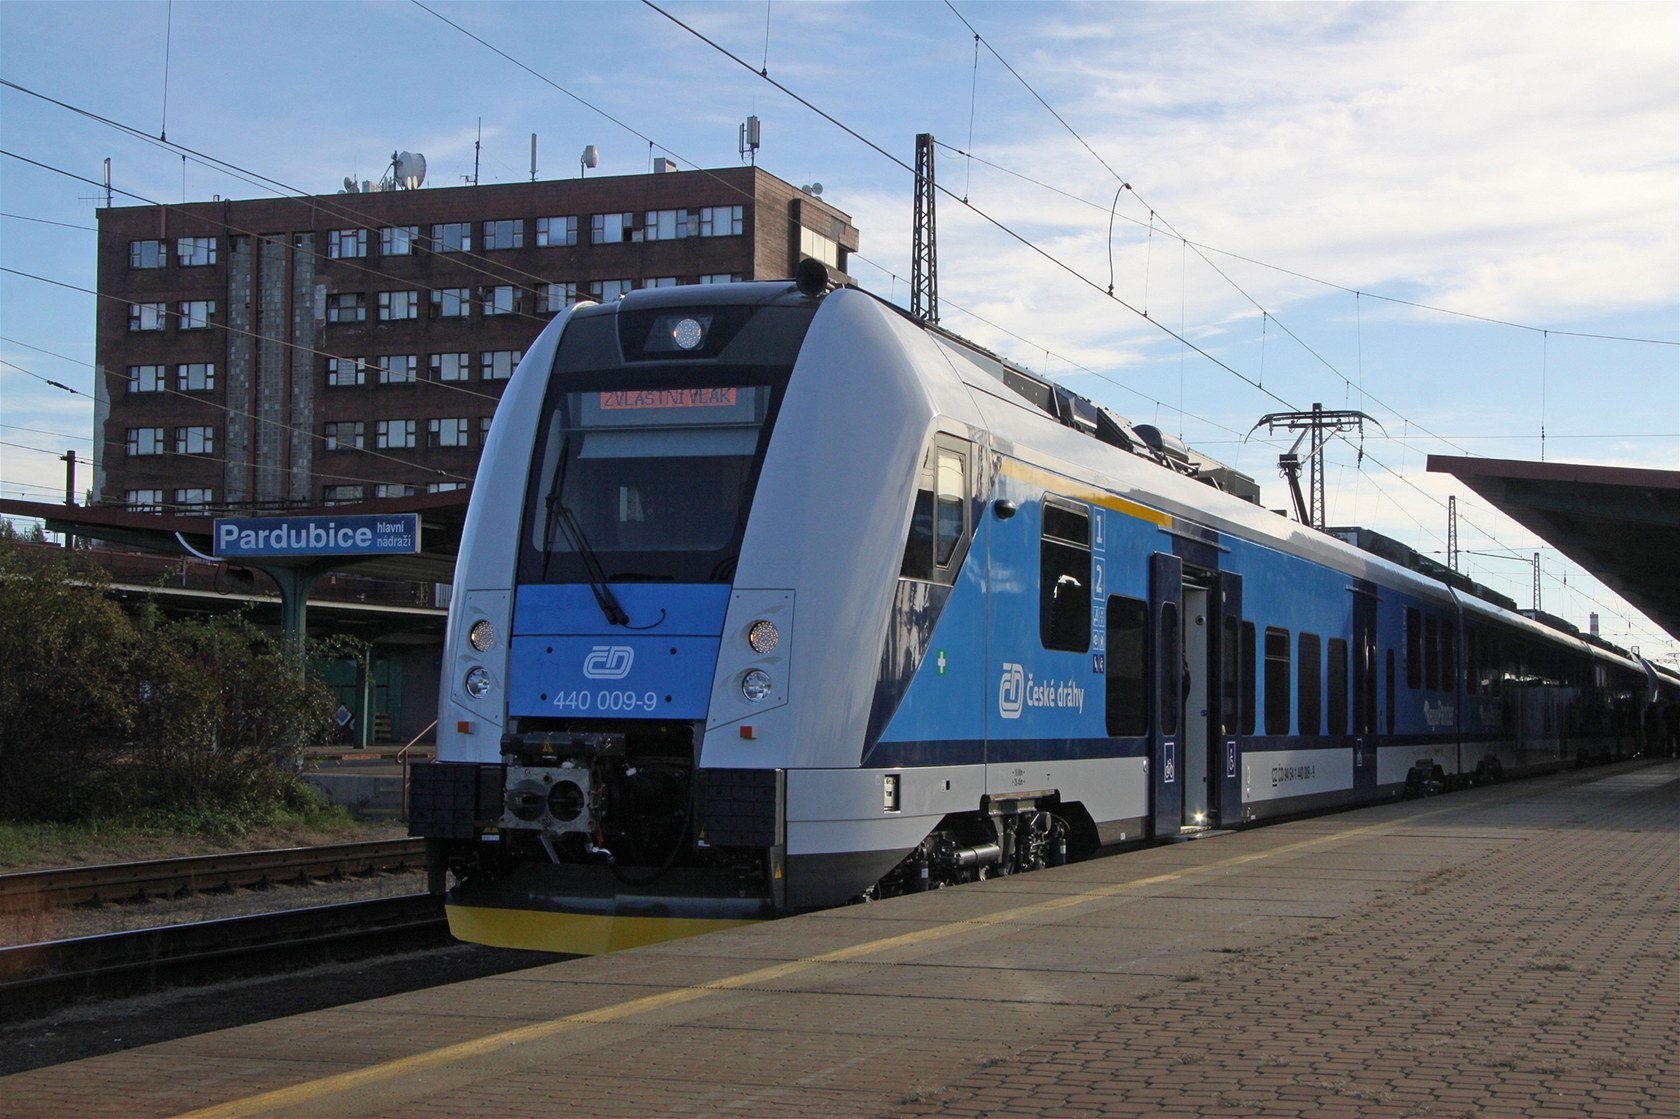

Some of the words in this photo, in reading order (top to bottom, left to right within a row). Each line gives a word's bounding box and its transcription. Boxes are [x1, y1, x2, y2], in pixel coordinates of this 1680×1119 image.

[220, 522, 373, 549] Pardubice
[377, 520, 404, 533] hlavní
[377, 534, 411, 547] nádraží
[1096, 514, 1103, 544] 1
[1096, 564, 1103, 594] 2
[553, 690, 591, 710] 440
[597, 690, 657, 711] 009-9
[1026, 673, 1055, 707] České
[1057, 679, 1084, 715] dráhy
